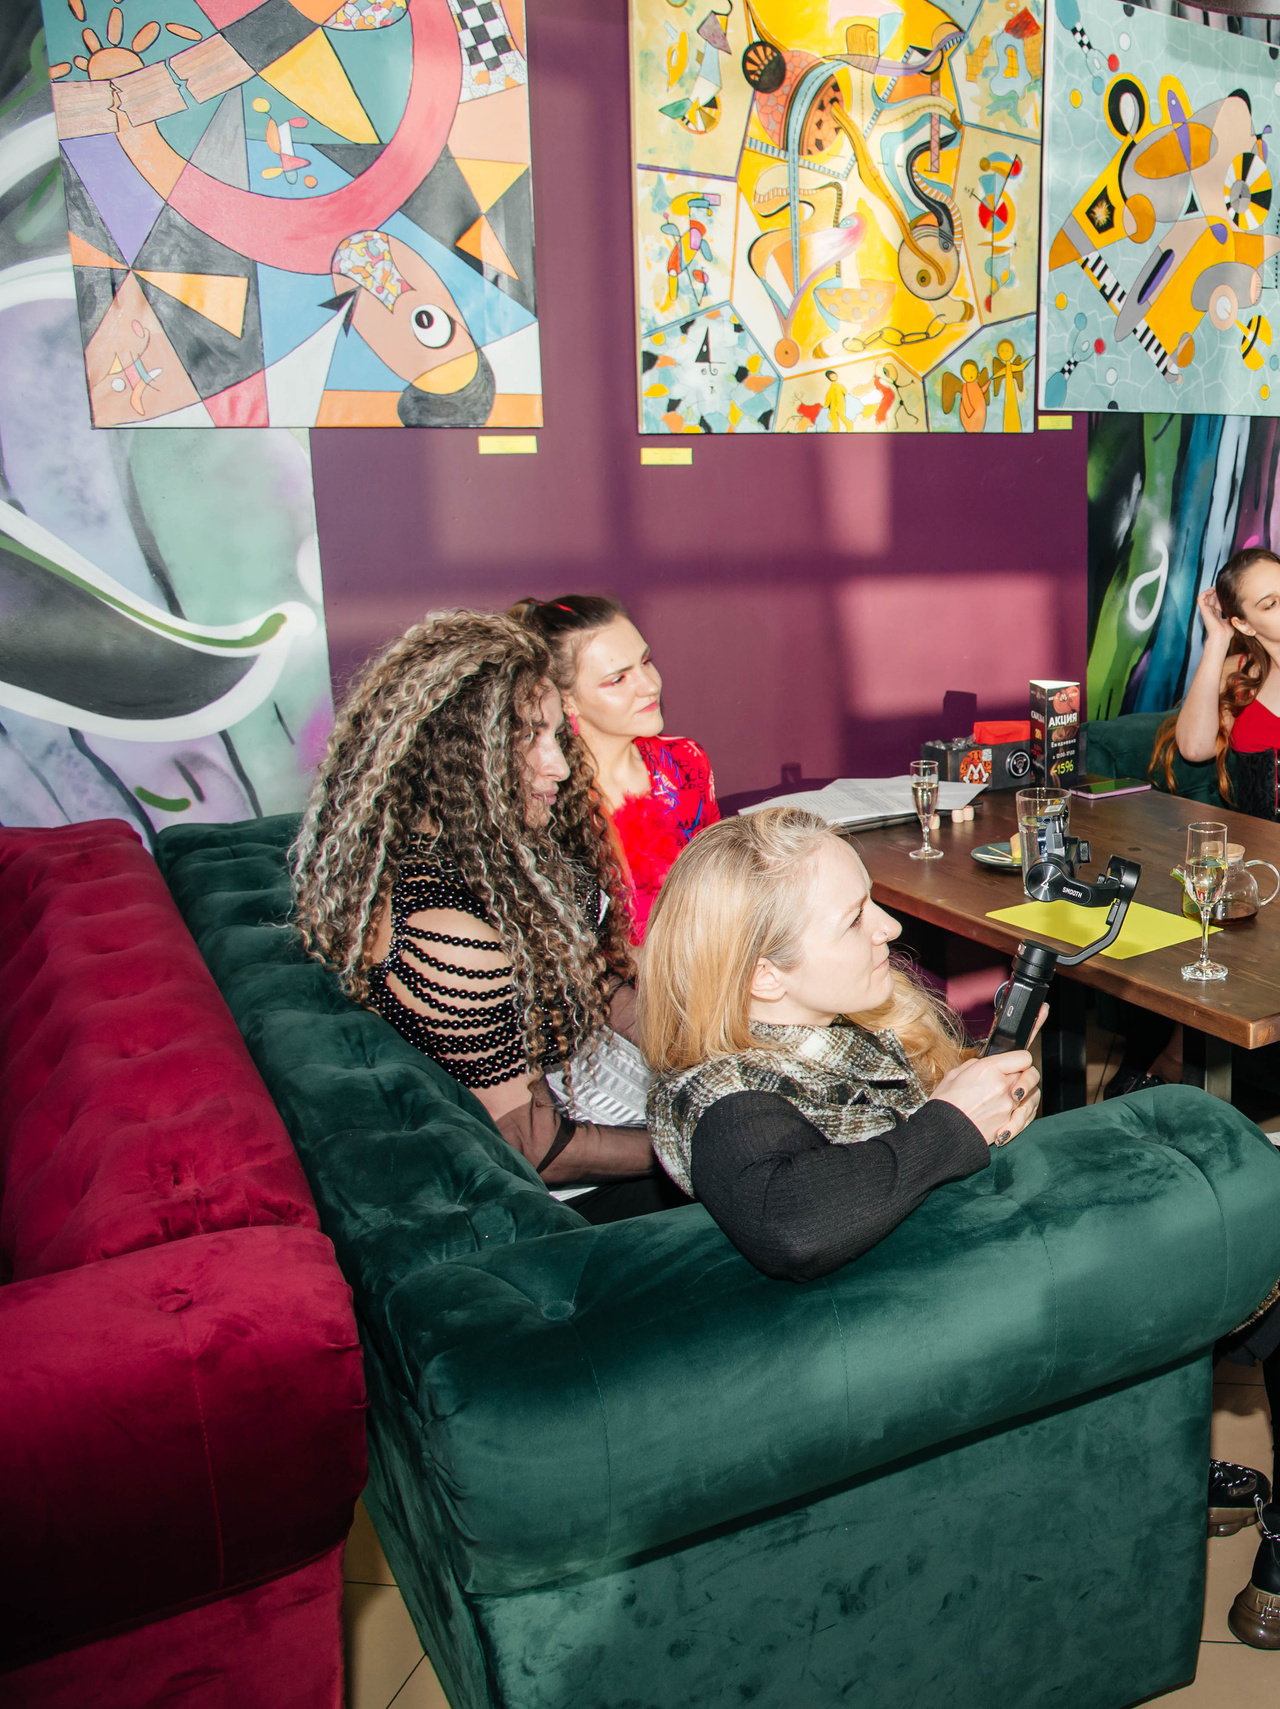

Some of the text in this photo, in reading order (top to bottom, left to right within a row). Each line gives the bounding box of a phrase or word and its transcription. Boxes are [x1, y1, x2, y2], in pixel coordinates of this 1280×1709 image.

[1048, 712, 1078, 728] АКЦИЯ
[1052, 759, 1074, 775] -15%
[1062, 886, 1083, 899] SMOOTH
